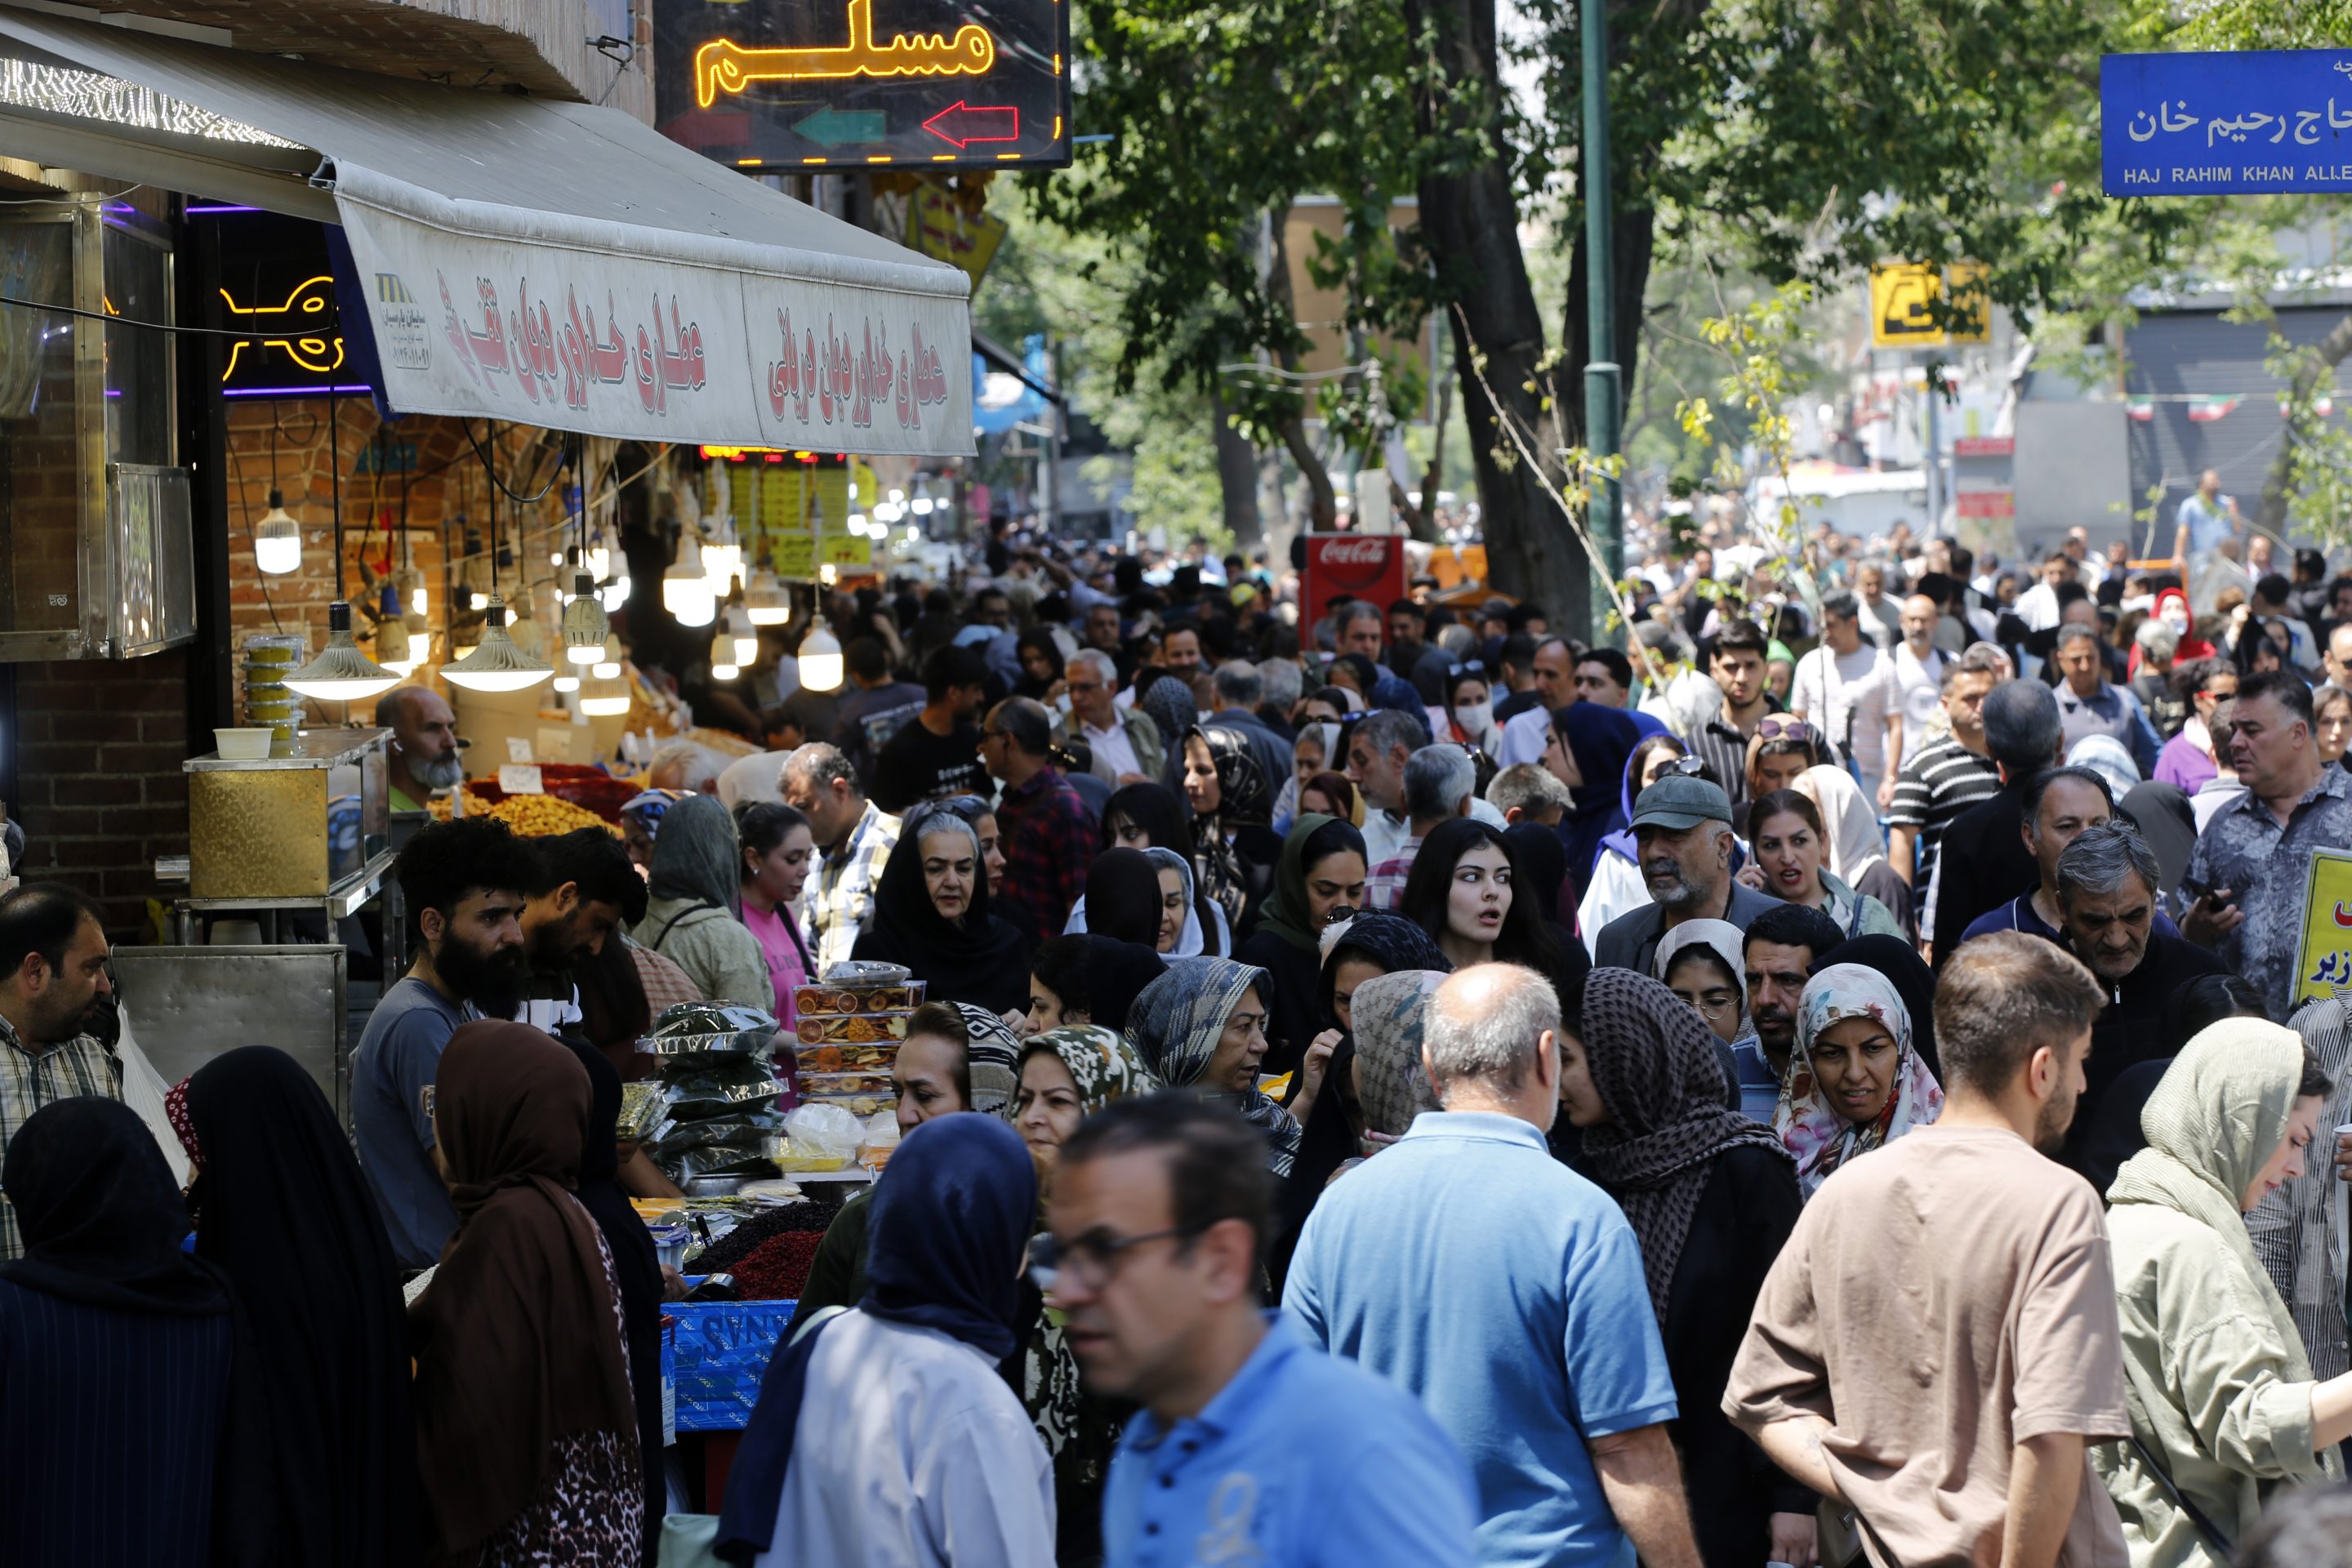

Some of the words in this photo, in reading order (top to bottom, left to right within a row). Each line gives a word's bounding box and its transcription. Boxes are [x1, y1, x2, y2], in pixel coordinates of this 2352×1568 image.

[696, 0, 994, 109] مسلم
[2128, 100, 2199, 142] خان
[2207, 110, 2287, 148] رحیم
[2124, 168, 2161, 184] HAJ
[2172, 167, 2232, 182] RAHIM
[2243, 166, 2294, 181] KHAN
[631, 292, 706, 418] عطاری
[895, 321, 949, 431] عطاری
